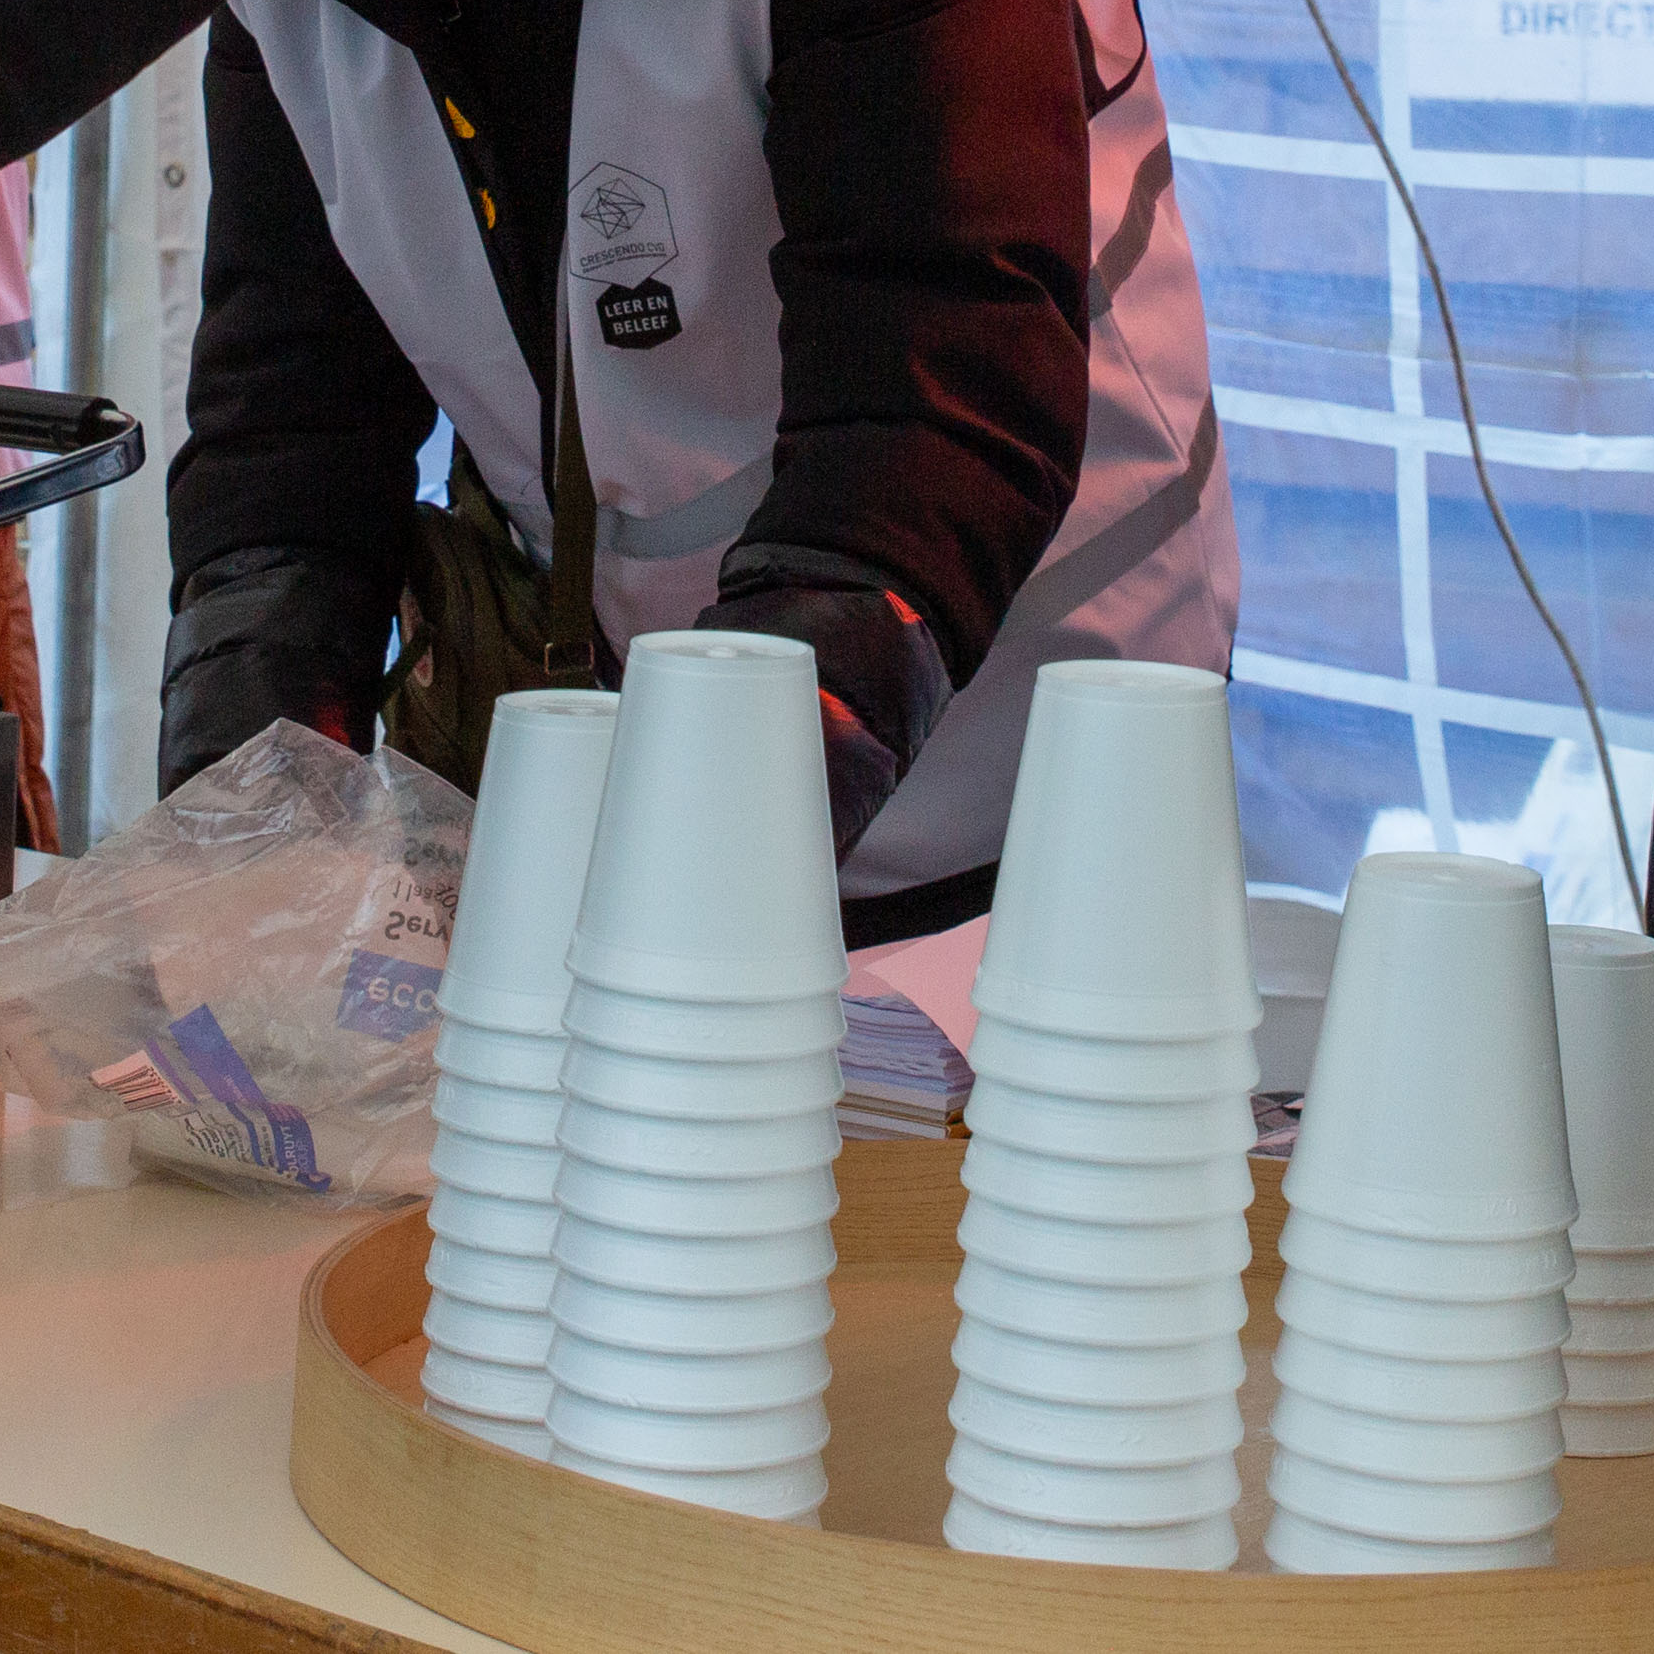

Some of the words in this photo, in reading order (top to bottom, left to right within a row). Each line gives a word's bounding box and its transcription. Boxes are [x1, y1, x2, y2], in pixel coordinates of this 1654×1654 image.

[579, 243, 645, 267] CRESCENDO
[604, 298, 643, 318] LEER
[647, 295, 669, 310] EN
[612, 314, 670, 336] BELEEF
[280, 1124, 300, 1175] OLRUYT
